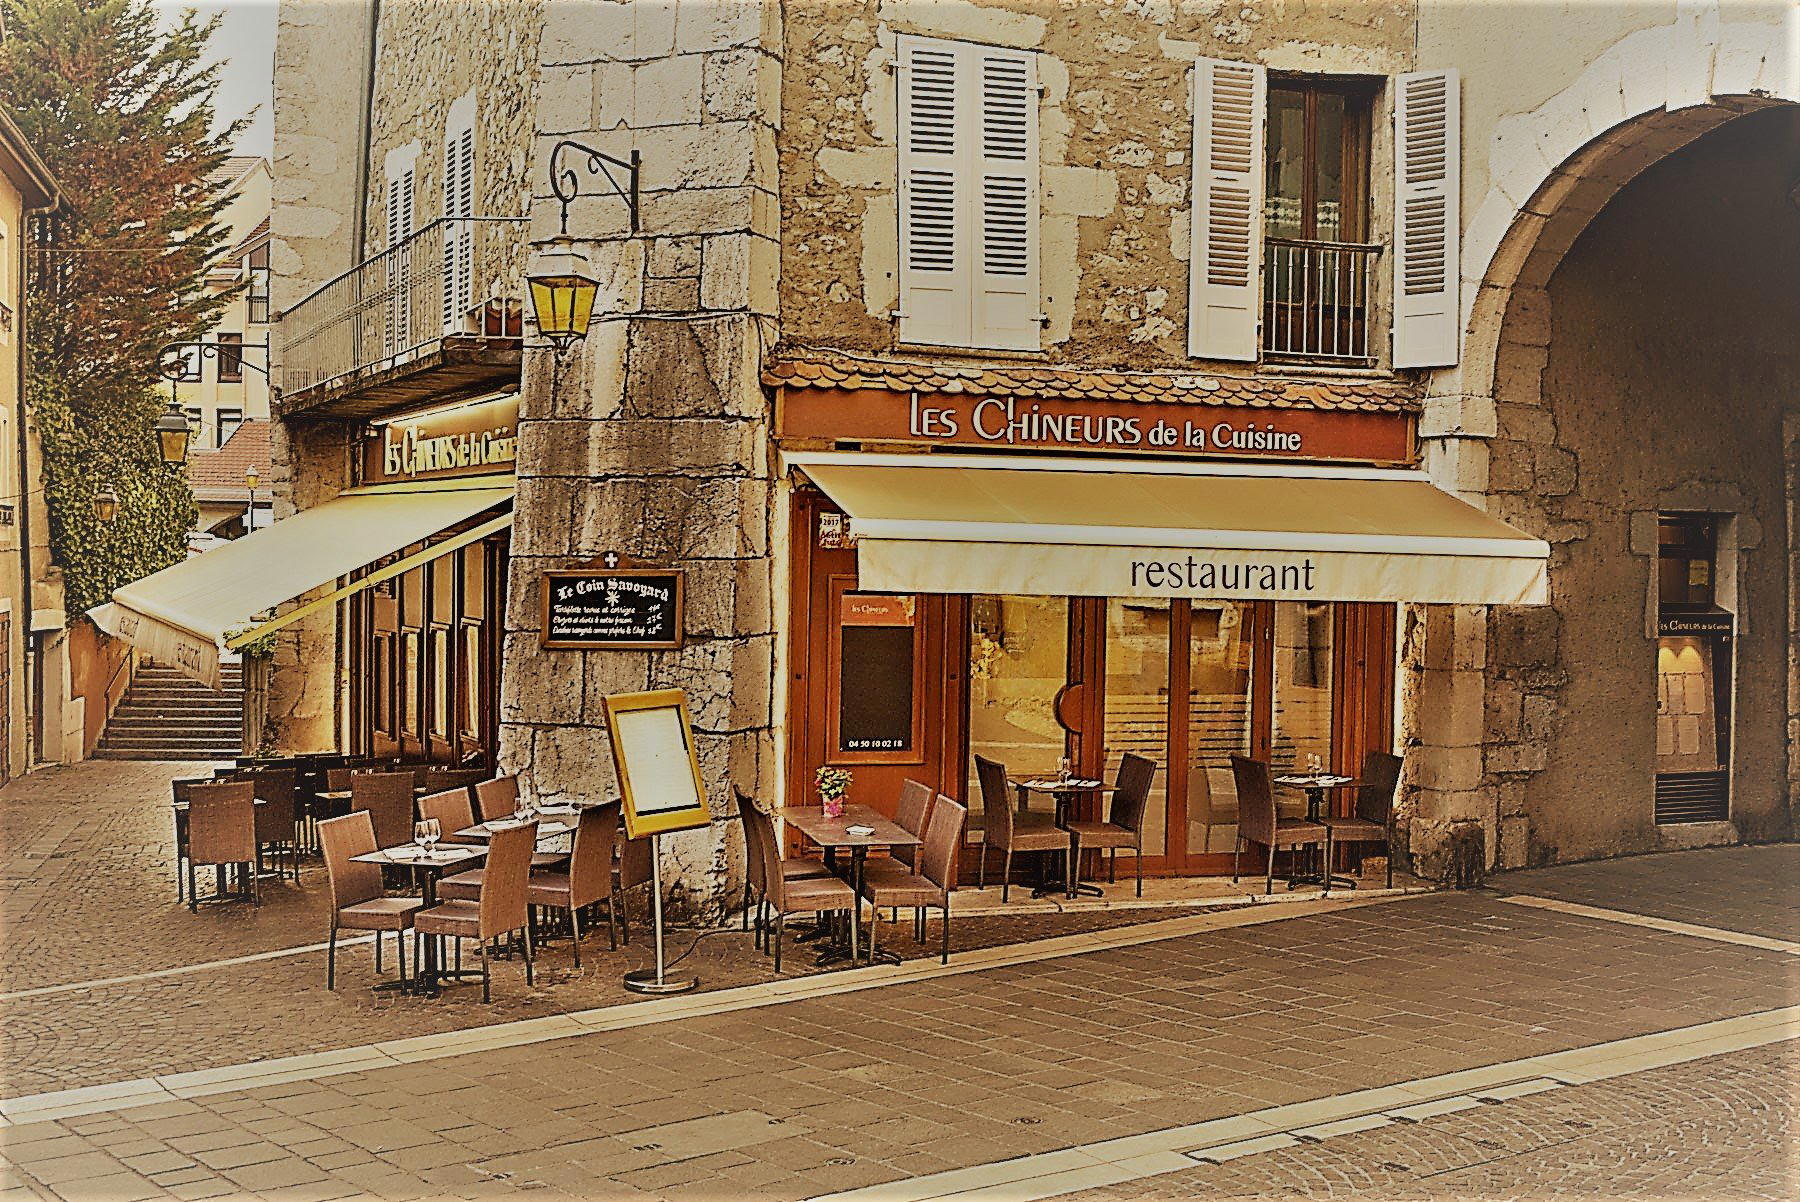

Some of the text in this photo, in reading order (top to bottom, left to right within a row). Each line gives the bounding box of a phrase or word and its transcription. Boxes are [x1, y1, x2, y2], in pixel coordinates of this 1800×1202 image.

[1149, 419, 1178, 446] de
[1184, 420, 1205, 448] la
[1211, 423, 1302, 452] Cuisine
[823, 518, 839, 526] 2017
[1131, 555, 1315, 591] restaurant
[557, 577, 669, 602] Le Coin Savoyard
[848, 740, 859, 748] 04
[860, 740, 870, 748] 50
[881, 740, 892, 748] 02
[893, 740, 903, 748] 18
